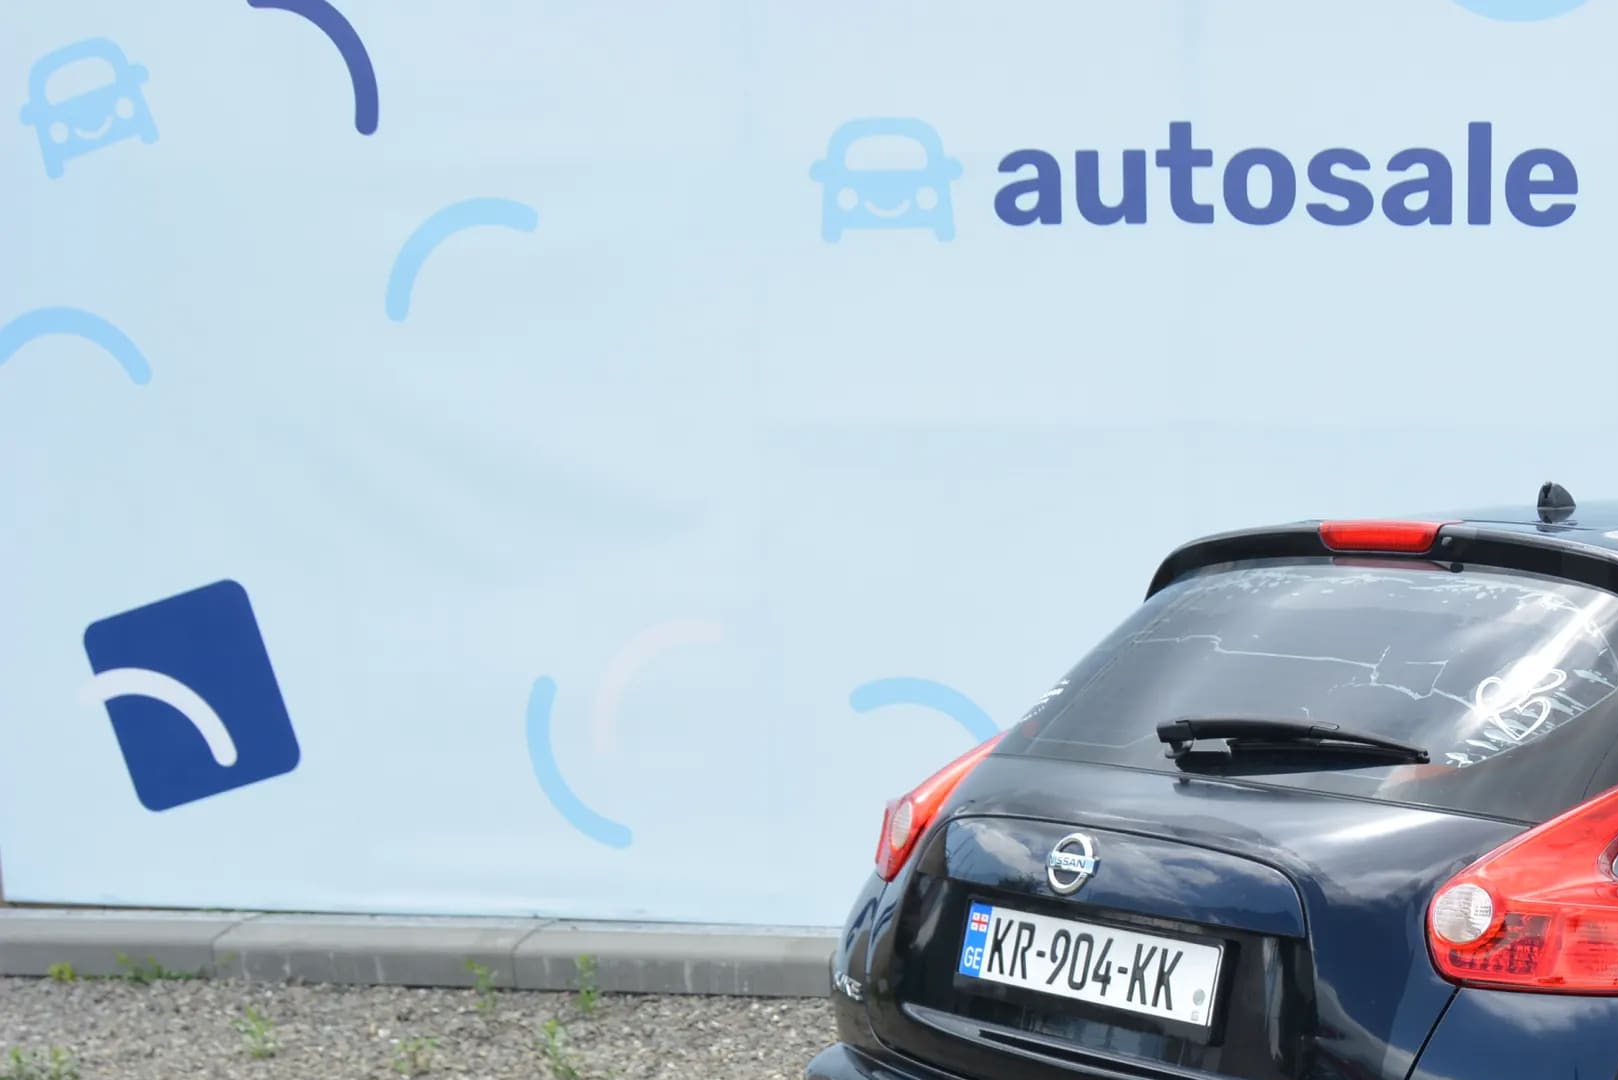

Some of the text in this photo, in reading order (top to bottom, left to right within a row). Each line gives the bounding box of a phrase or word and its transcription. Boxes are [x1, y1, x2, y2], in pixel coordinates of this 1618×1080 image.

[993, 120, 1580, 228] autosale
[1049, 854, 1087, 869] NISSAN
[963, 917, 1184, 1011] GE KR-904-KK
